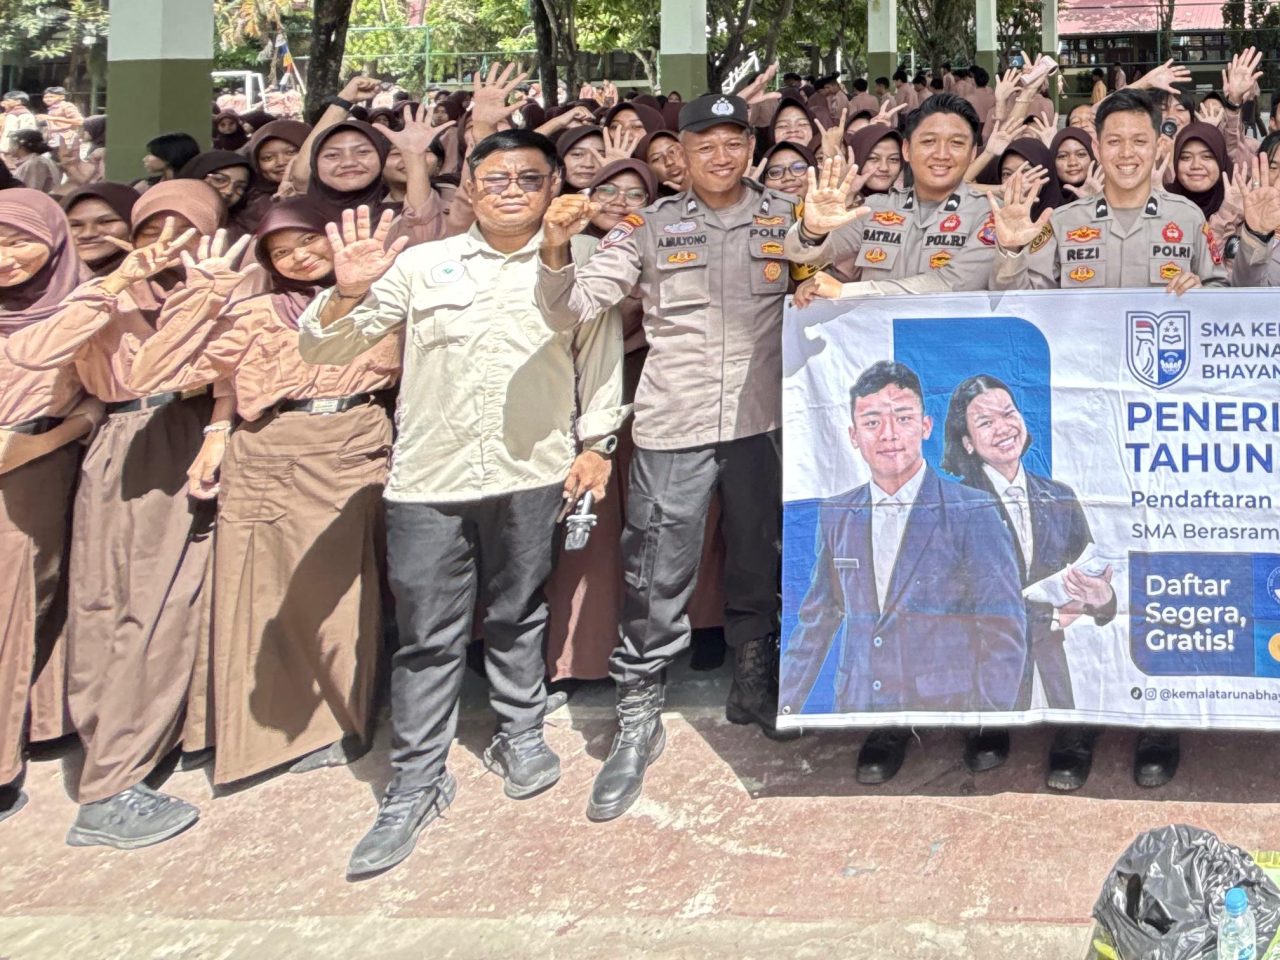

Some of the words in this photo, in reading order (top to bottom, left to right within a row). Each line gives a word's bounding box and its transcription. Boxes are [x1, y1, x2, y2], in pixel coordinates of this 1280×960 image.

[751, 228, 786, 238] POLR
[863, 229, 901, 244] SATRIA
[926, 233, 967, 246] POLRI
[658, 234, 707, 248] A.MULYONO
[1067, 247, 1100, 261] REZI
[1153, 245, 1190, 258] POLRI
[1201, 322, 1245, 337] SMA
[1125, 443, 1273, 474] TAHUN
[1131, 490, 1271, 509] Pendaftaran
[1132, 523, 1176, 539] SMA
[1146, 574, 1230, 596] Daftar
[1145, 602, 1247, 629] Segera,
[1146, 629, 1235, 651] Gratis!
